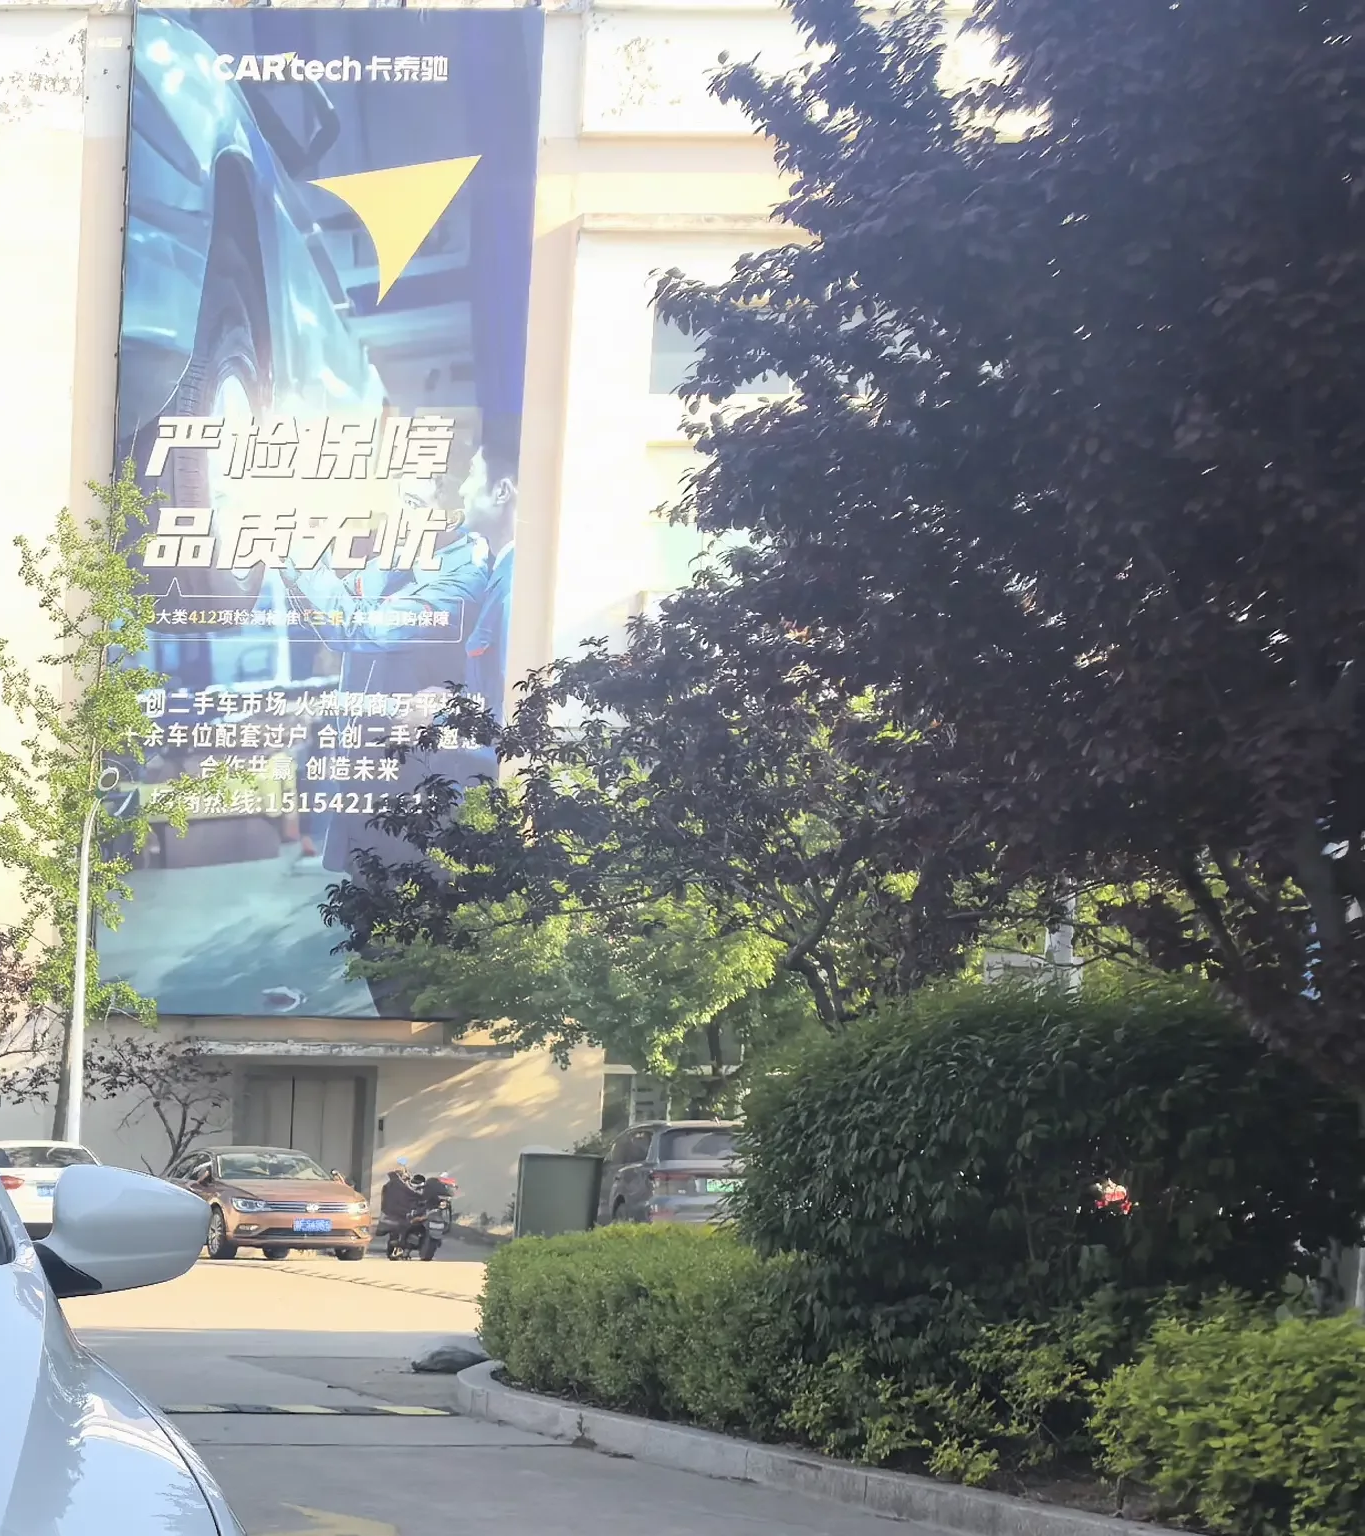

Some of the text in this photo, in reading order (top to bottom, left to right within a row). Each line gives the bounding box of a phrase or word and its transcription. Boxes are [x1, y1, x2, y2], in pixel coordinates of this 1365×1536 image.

[212, 53, 449, 83] CARtech 卡泰驰
[144, 415, 456, 480] 严检保障
[142, 507, 449, 572] 品质无忧
[137, 690, 288, 716] 创二手车市场
[305, 756, 400, 782] 创造未来
